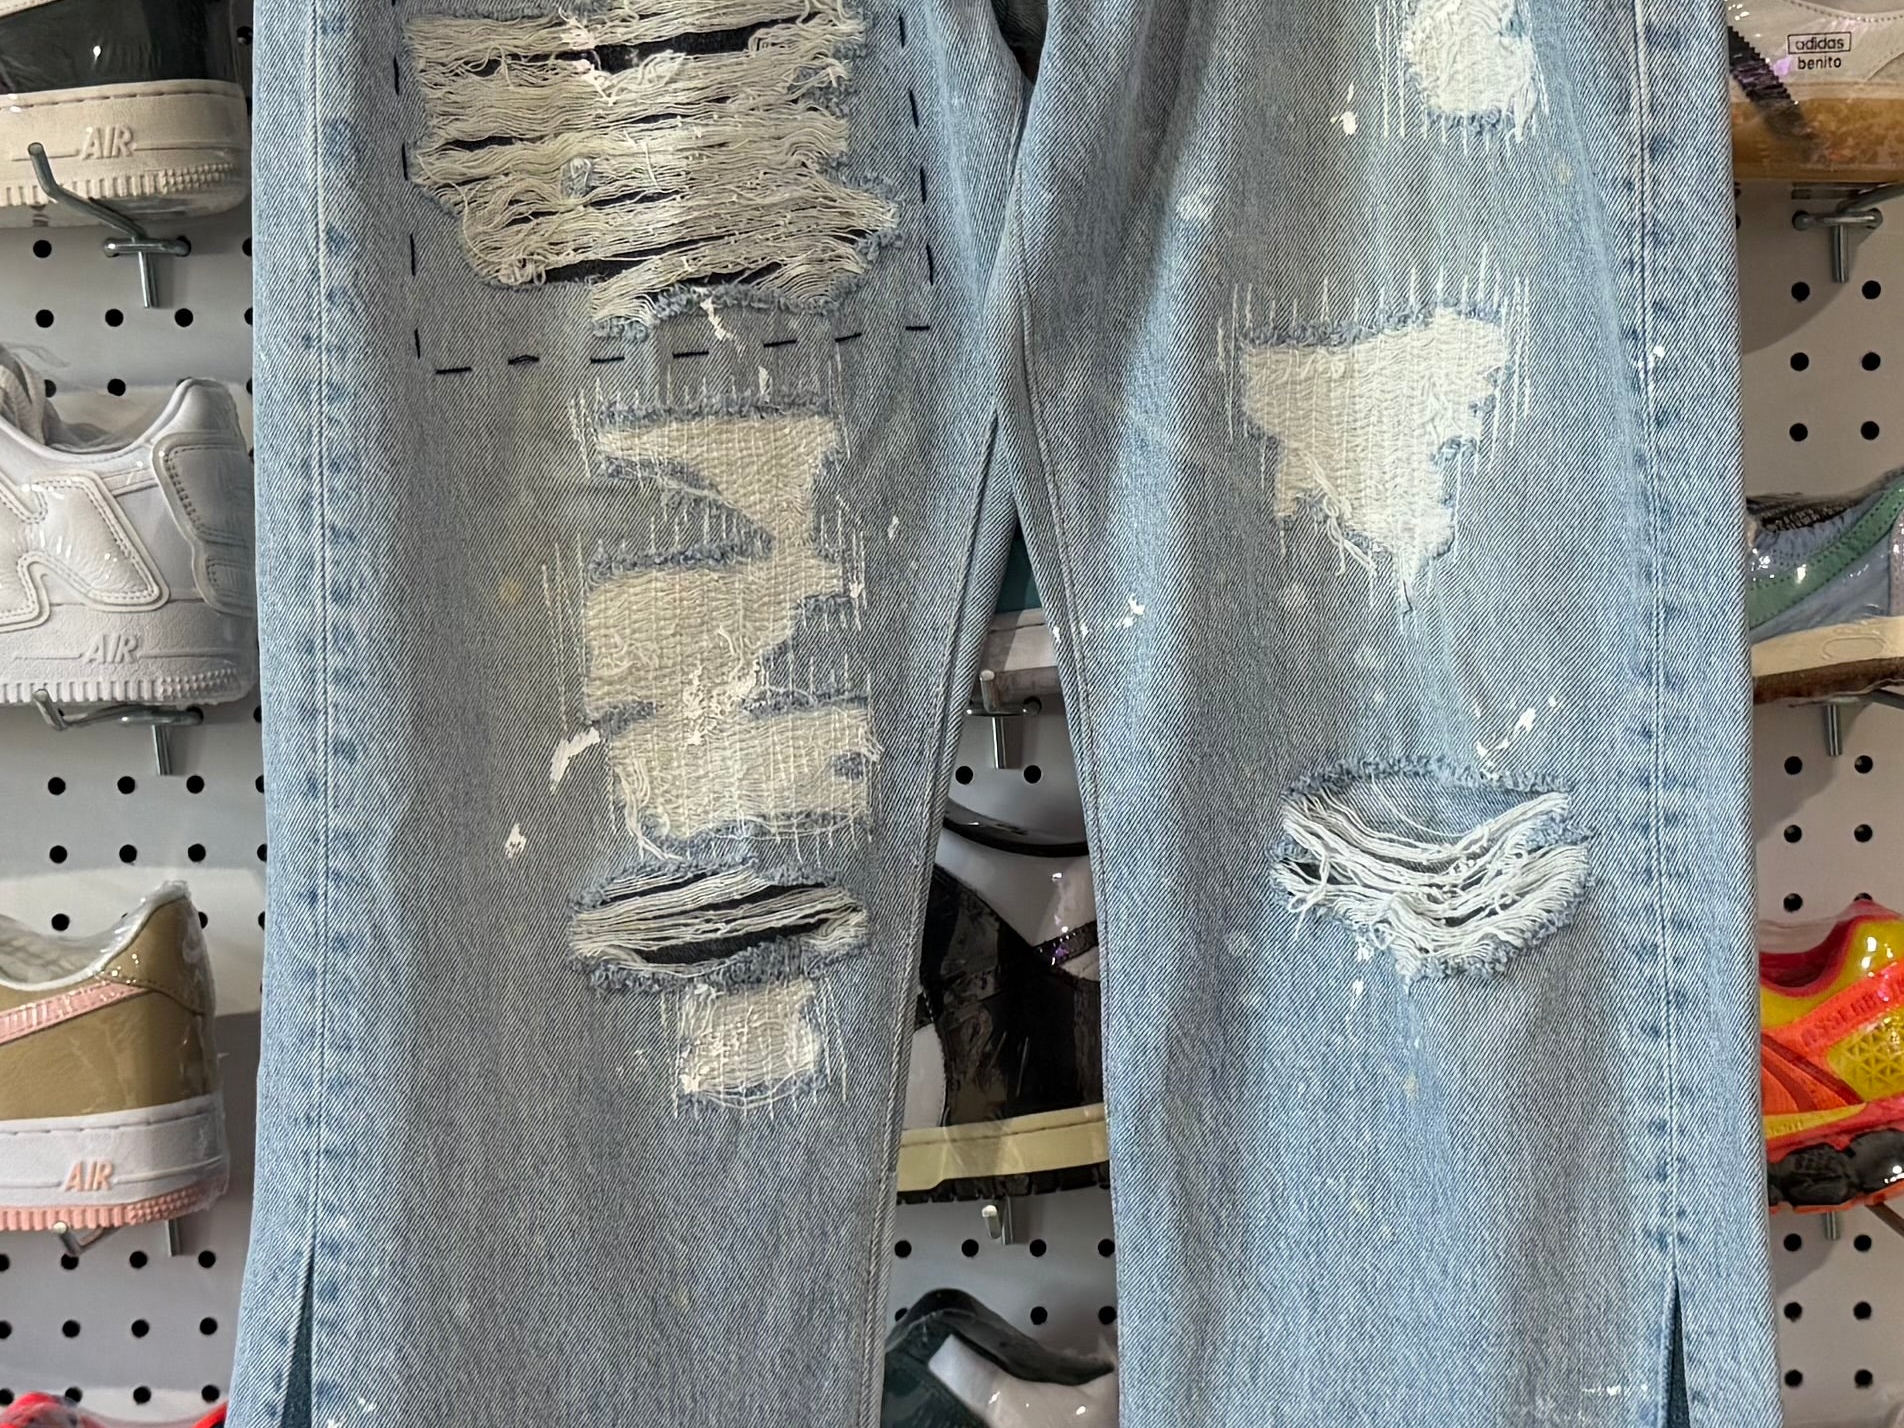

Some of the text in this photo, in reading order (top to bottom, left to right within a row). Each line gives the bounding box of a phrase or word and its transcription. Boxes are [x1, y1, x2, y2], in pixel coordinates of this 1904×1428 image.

[1795, 36, 1845, 51] adidas
[1797, 55, 1842, 70] benito
[81, 124, 136, 161] AIR
[84, 632, 140, 665] AIR
[64, 1159, 114, 1192] AIR
